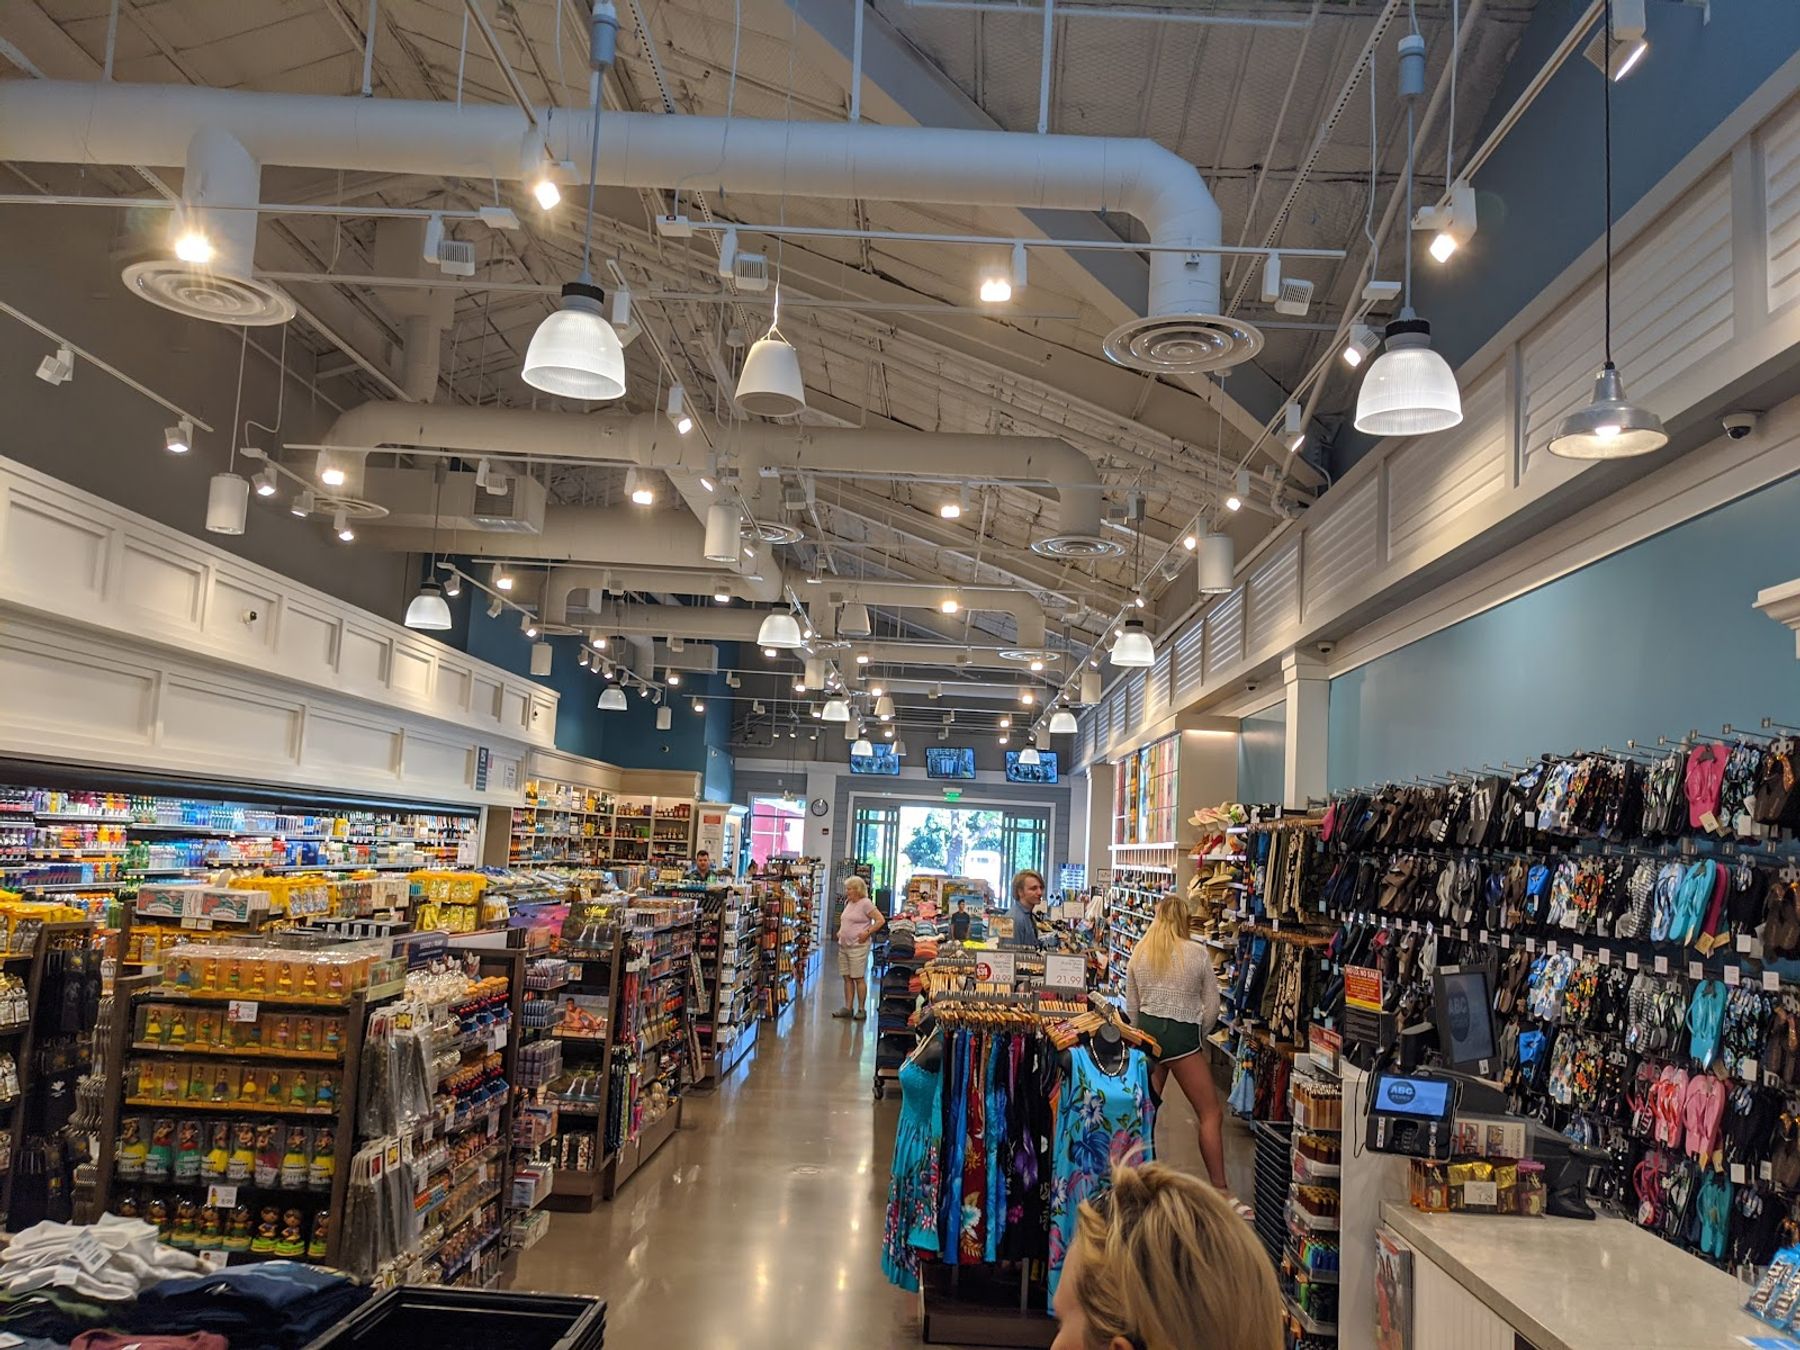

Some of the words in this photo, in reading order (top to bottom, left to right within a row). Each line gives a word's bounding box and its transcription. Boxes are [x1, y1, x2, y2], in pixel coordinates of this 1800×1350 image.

[1056, 975, 1082, 985] 21.99
[1448, 997, 1467, 1014] ABC
[1390, 1085, 1413, 1095] ABC
